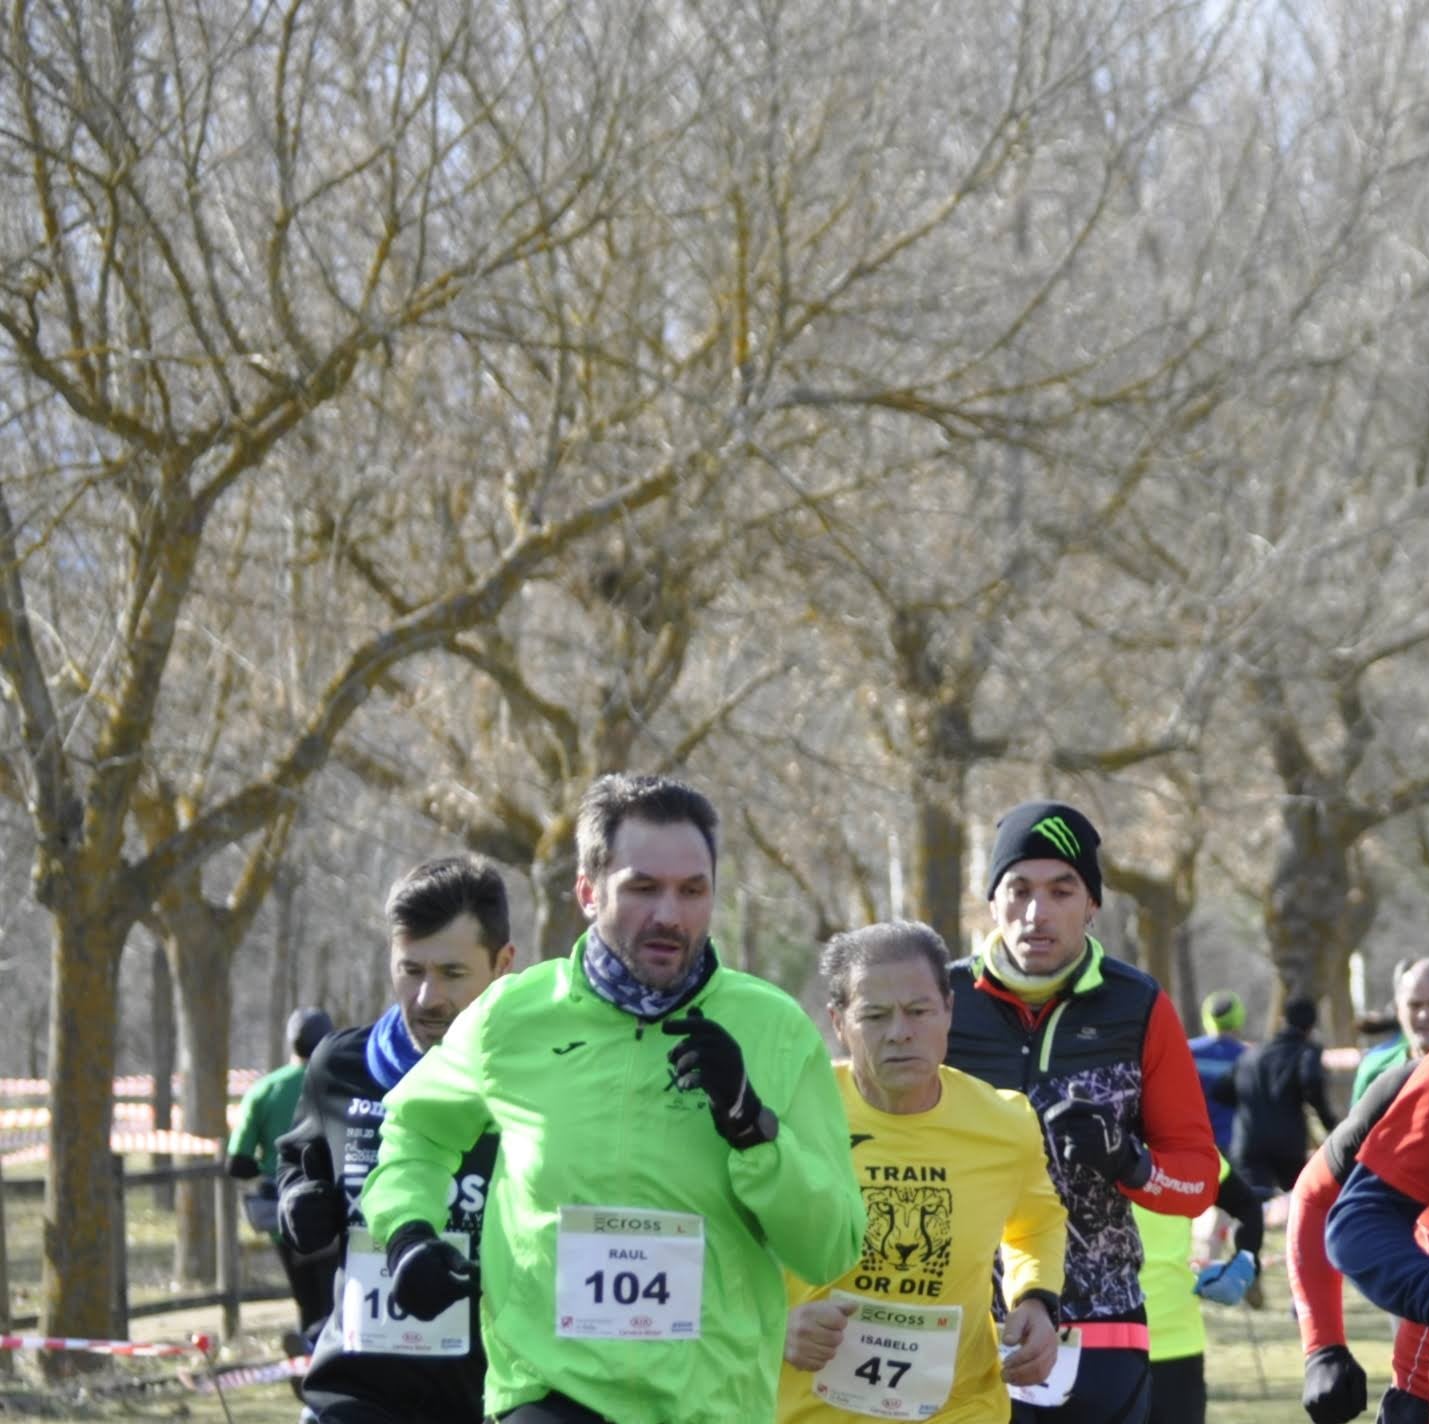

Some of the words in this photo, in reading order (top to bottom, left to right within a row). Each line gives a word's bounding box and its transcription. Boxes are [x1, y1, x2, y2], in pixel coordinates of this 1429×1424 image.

[865, 1166, 946, 1182] TRAIN
[608, 1248, 648, 1260] RAUL
[585, 1270, 670, 1305] 104
[854, 1275, 890, 1293] OR
[900, 1280, 943, 1297] DIE
[937, 1317, 948, 1328] M
[860, 1335, 919, 1352] ISABELO
[854, 1356, 912, 1389] 47
